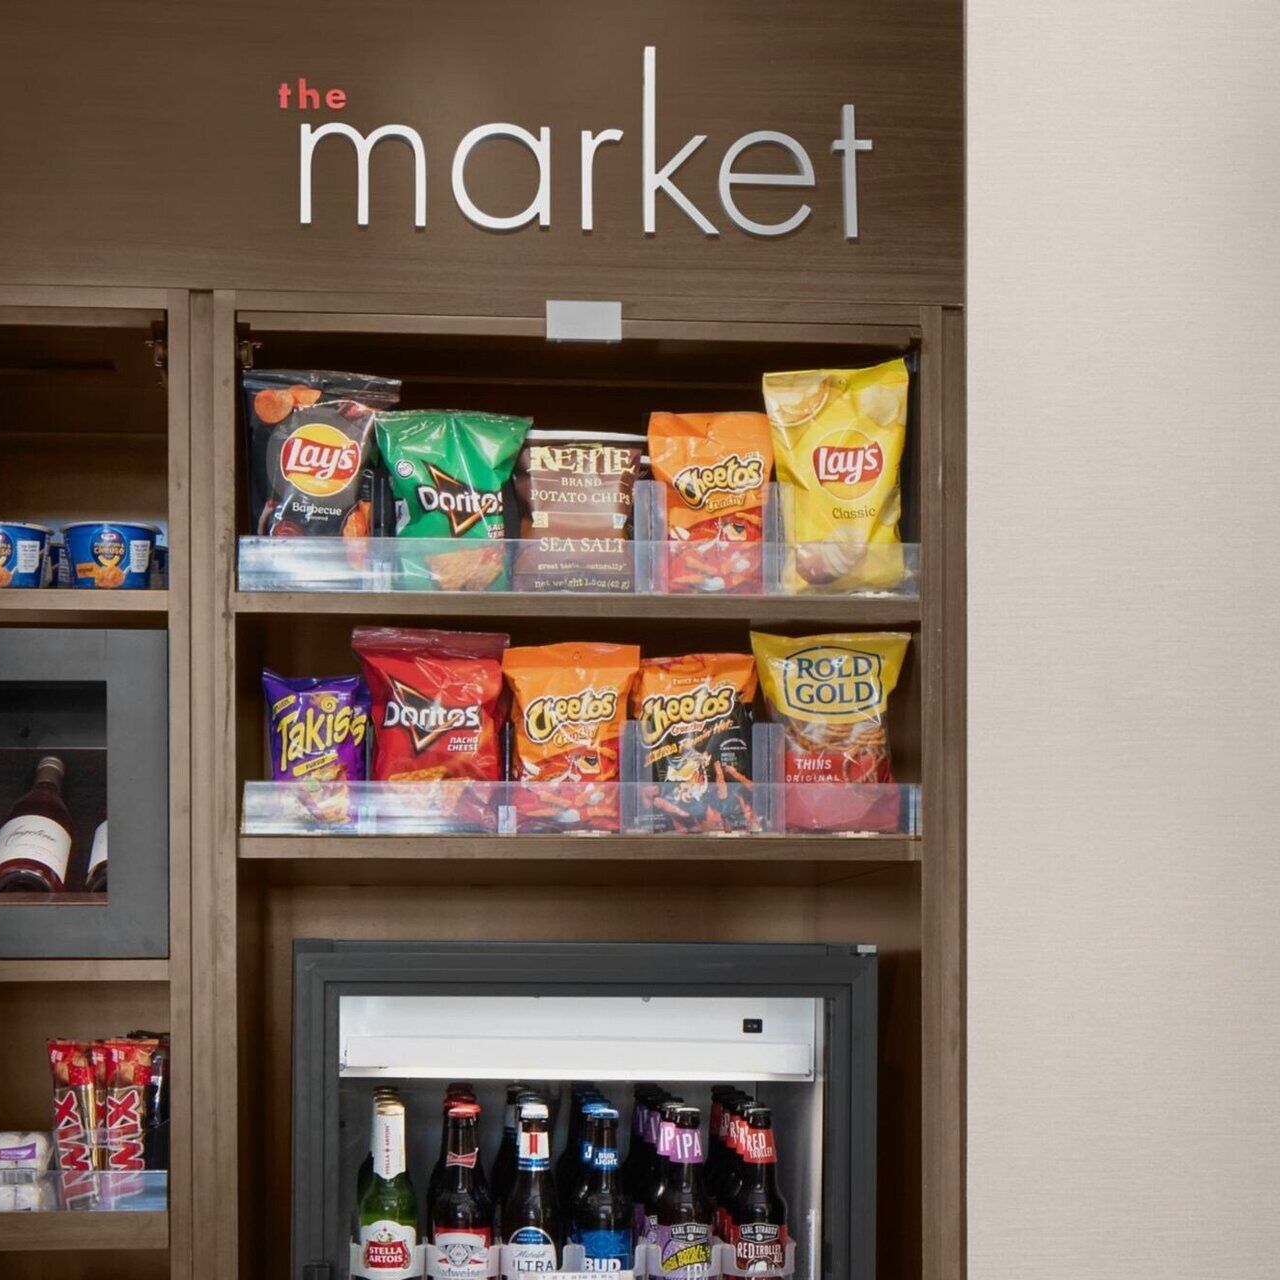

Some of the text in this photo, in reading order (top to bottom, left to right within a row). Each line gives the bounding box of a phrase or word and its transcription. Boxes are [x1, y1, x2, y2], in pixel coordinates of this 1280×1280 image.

[278, 79, 346, 110] the
[300, 46, 873, 238] market
[286, 437, 355, 479] Lay's
[819, 444, 879, 484] Lay's
[561, 478, 602, 486] BRAND
[674, 458, 764, 508] Cheetos
[531, 490, 631, 505] POTATO CHIPS
[292, 502, 342, 516] Barbecue
[832, 506, 875, 520] Classic
[539, 537, 625, 553] SEA SALT
[796, 656, 873, 680] ROLD
[795, 681, 874, 704] GOLD
[384, 701, 480, 728] Doritos
[527, 689, 617, 742] Cheetos
[641, 686, 732, 746] Cheetos
[796, 758, 832, 771] THINS
[787, 774, 840, 782] ORIGINAL
[55, 1091, 97, 1203] TWIX
[107, 1088, 145, 1200] TWIX
[676, 1135, 701, 1160] IPA
[746, 1133, 766, 1152] RED
[595, 1158, 617, 1166] LIGHT
[369, 1246, 403, 1256] STELLA
[369, 1255, 403, 1263] ARTOIS
[738, 1242, 754, 1259] RED
[584, 1258, 621, 1272] BUD
